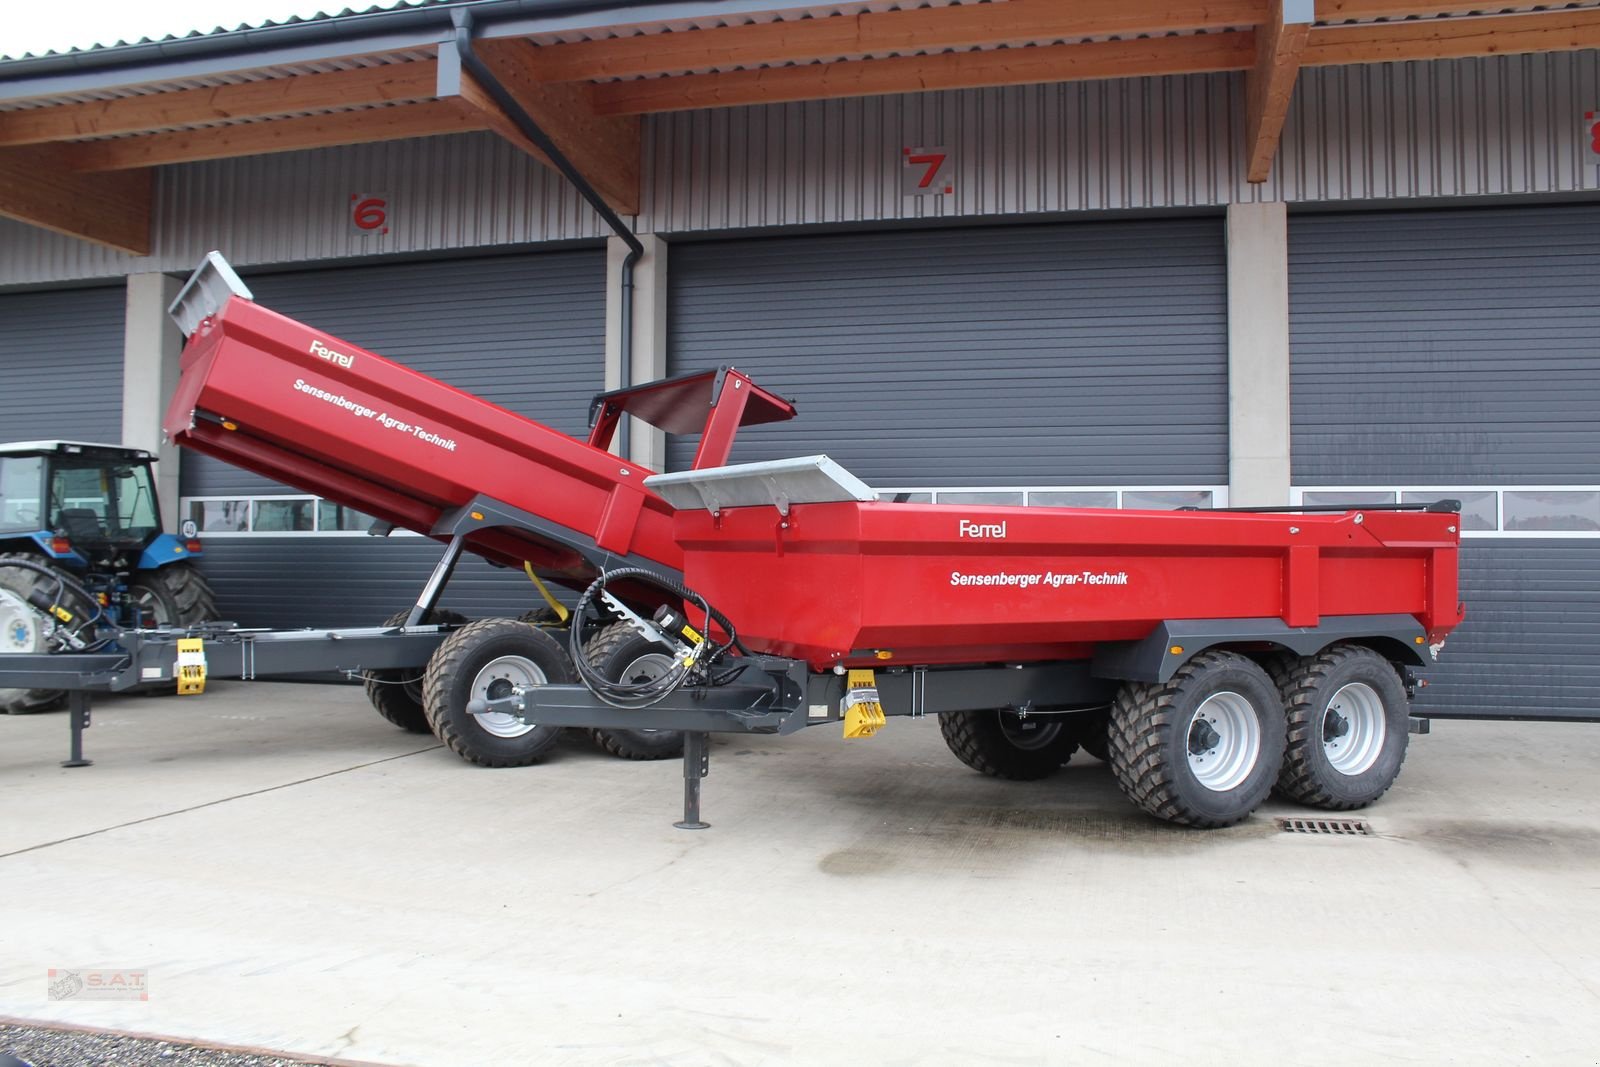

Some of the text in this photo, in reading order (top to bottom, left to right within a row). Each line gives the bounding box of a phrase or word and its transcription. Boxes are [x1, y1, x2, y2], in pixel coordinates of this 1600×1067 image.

[908, 154, 946, 188] 7
[354, 198, 386, 230] 6
[309, 340, 354, 369] Ferrel
[293, 378, 457, 452] Sensenberger Agrar-Technik
[959, 519, 1007, 538] Ferrel
[950, 571, 1128, 589] Sensenberger Agrar-Technik
